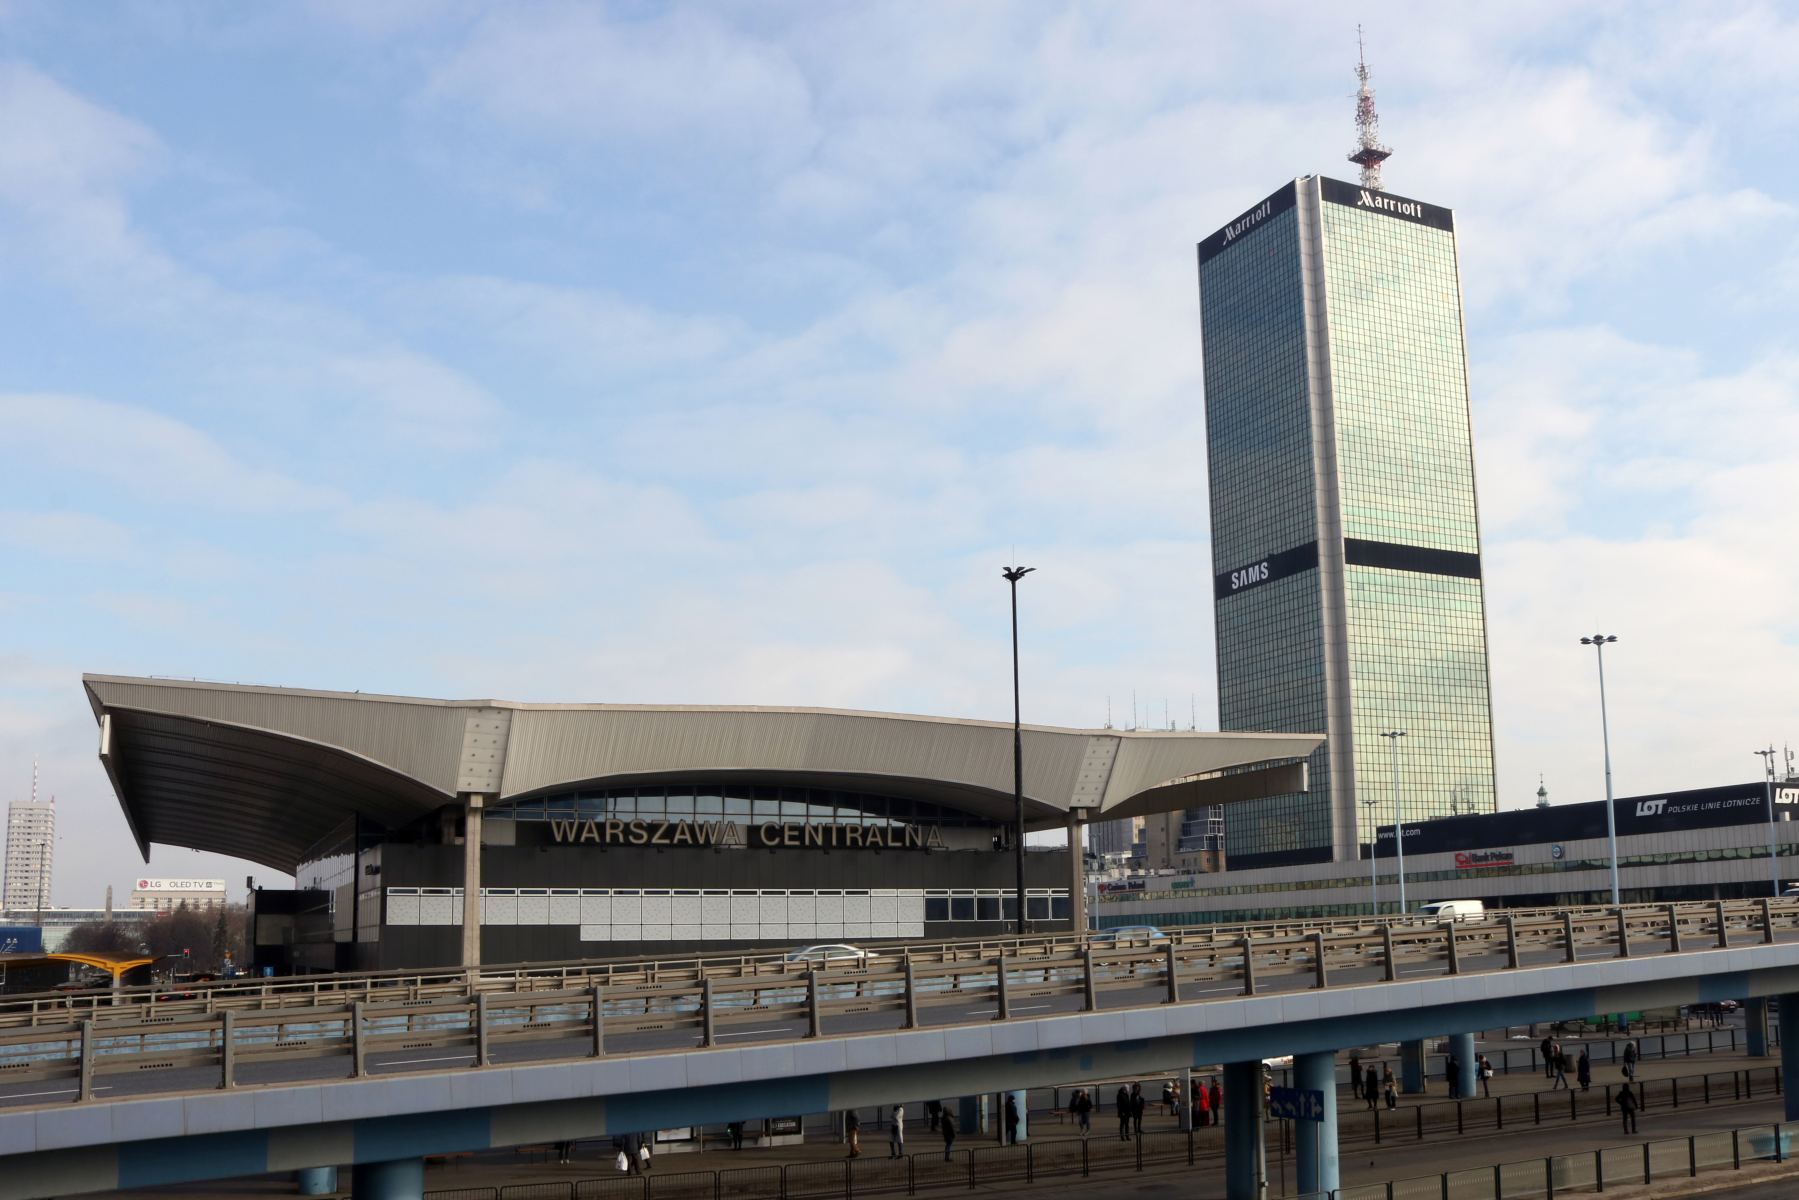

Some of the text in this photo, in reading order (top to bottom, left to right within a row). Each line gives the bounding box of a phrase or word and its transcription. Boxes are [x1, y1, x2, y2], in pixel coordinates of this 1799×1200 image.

[1357, 190, 1422, 218] Marriott
[1223, 200, 1271, 246] Marriott
[1231, 562, 1269, 590] SAMS
[1636, 797, 1761, 817] LOT POLSKIE LINIE LOTNICZE
[1775, 787, 1799, 804] LOT
[550, 818, 945, 847] WARSZAWA CENTRALNA
[1378, 829, 1421, 839] www.t.com
